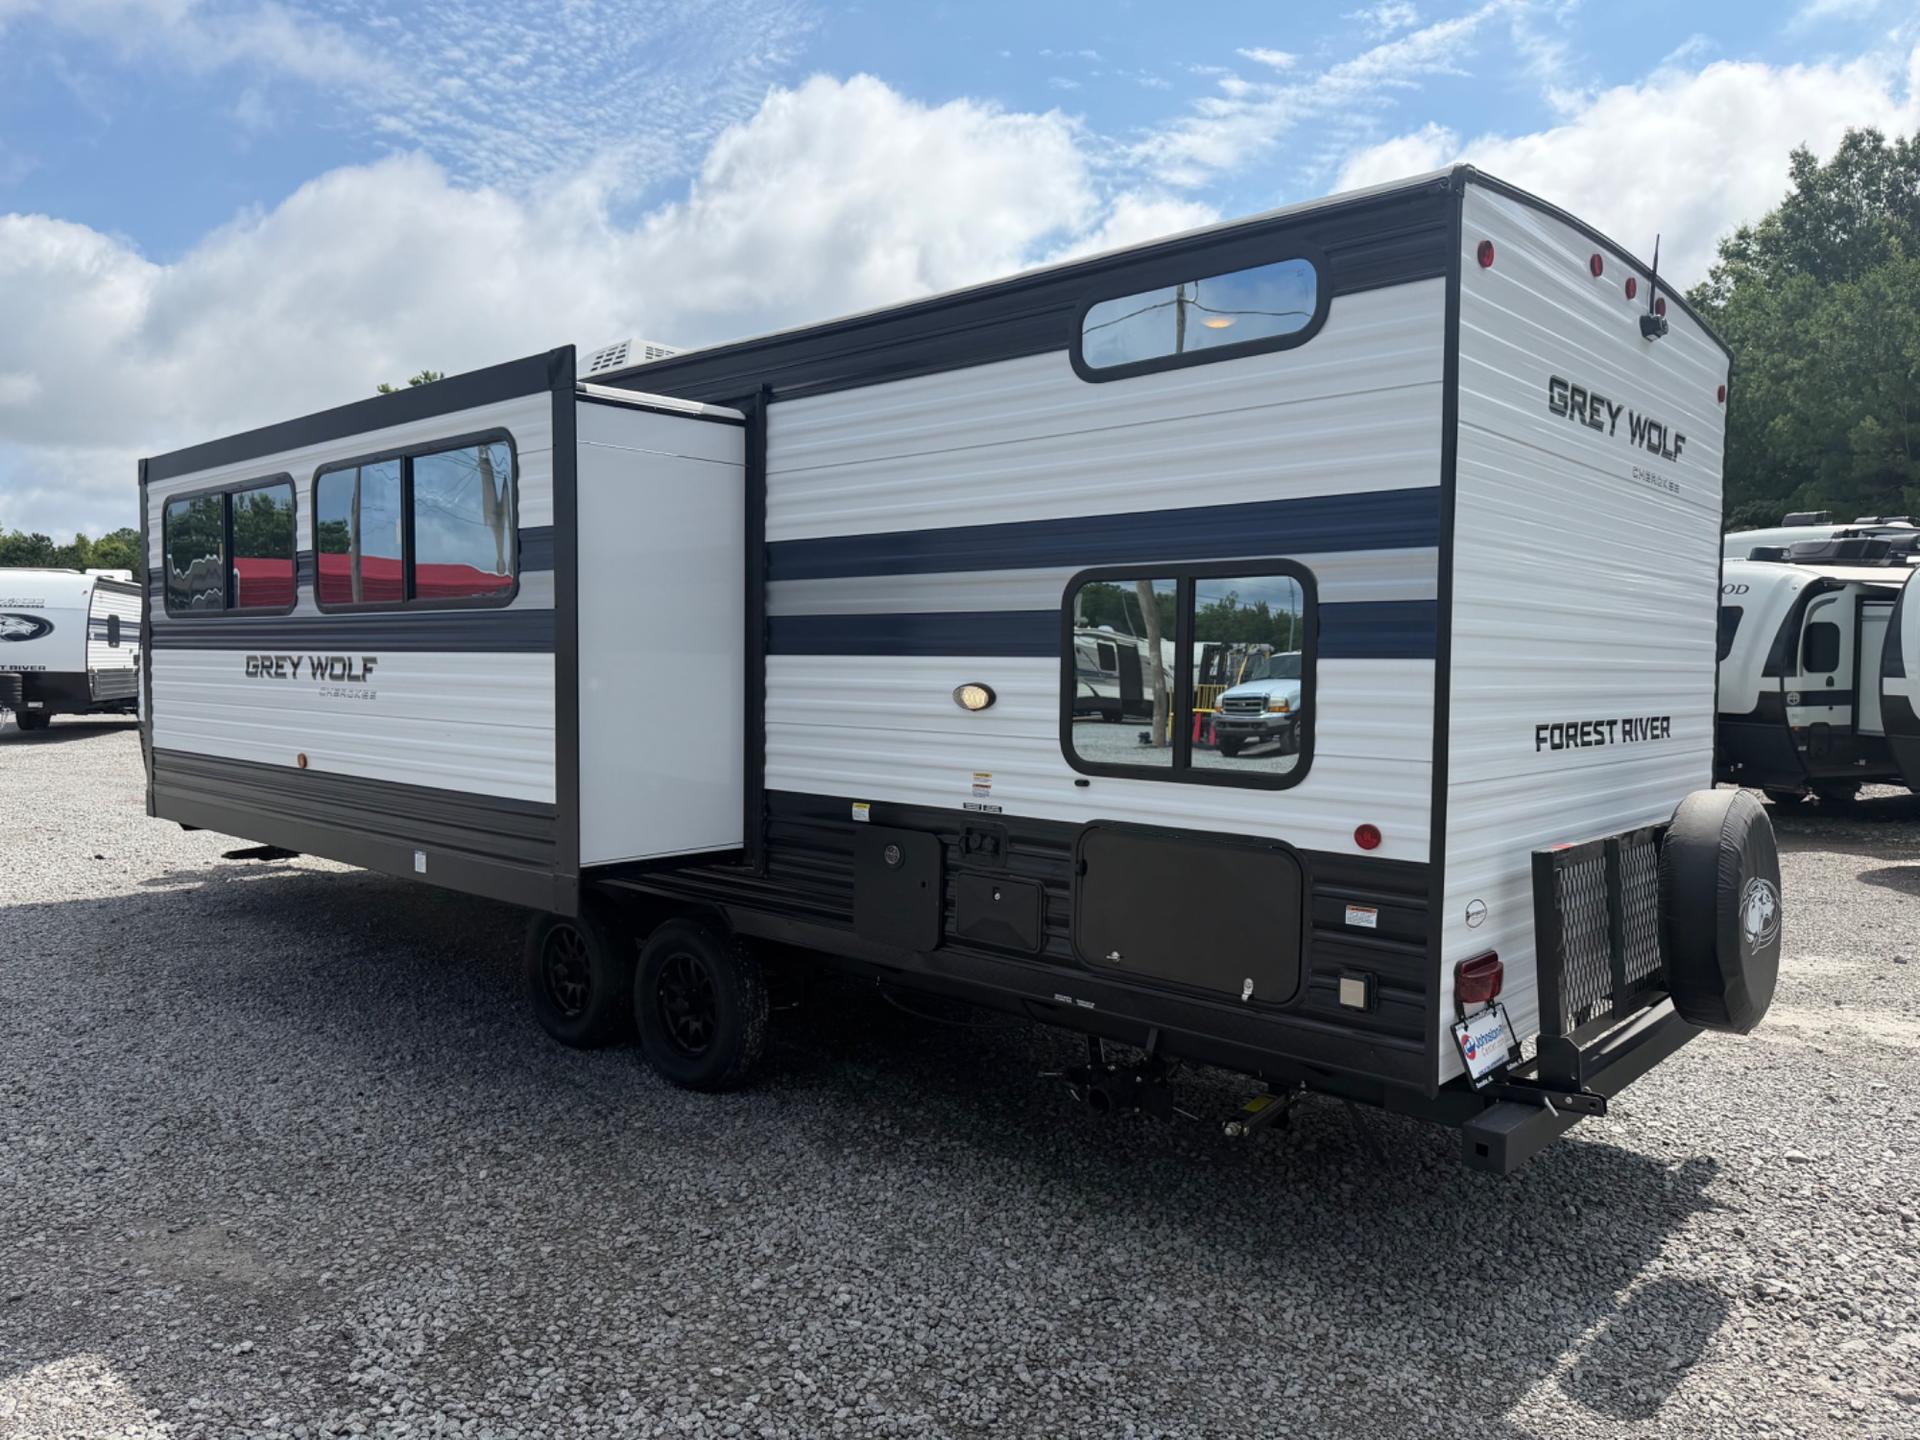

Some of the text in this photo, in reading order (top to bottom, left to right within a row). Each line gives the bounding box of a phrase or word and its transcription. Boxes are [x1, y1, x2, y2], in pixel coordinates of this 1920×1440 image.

[1548, 374, 1686, 463] GREY WOLF
[245, 654, 378, 682] GREY WOLF
[1535, 715, 1671, 752] FOREST RIVER
